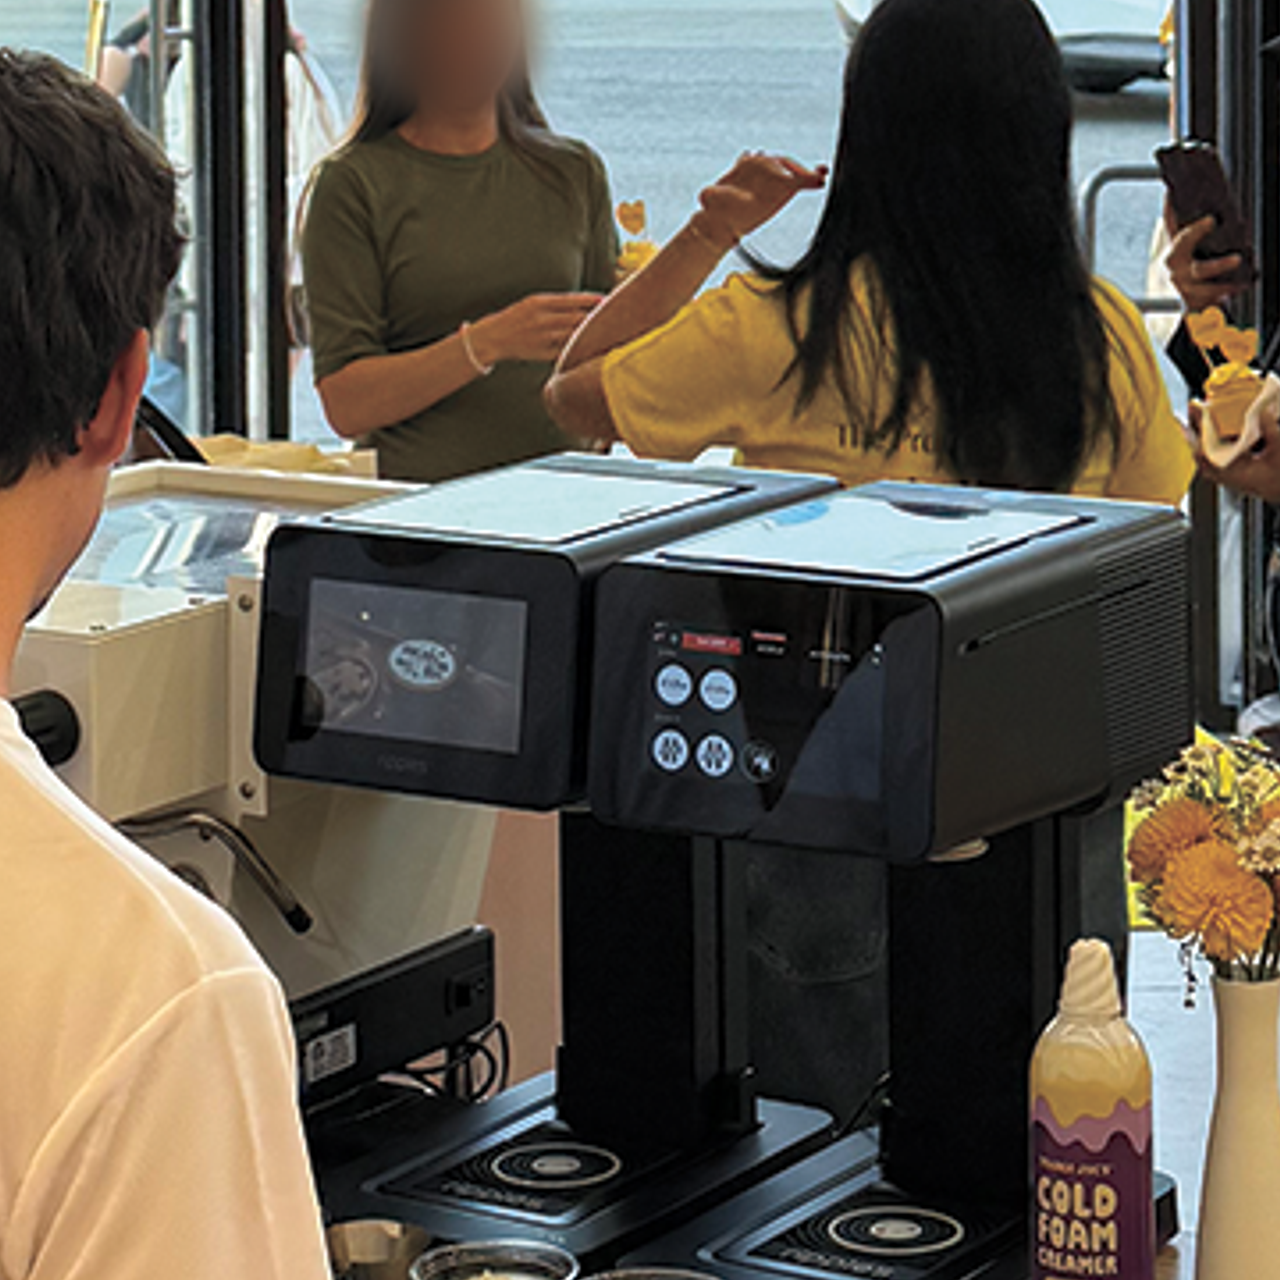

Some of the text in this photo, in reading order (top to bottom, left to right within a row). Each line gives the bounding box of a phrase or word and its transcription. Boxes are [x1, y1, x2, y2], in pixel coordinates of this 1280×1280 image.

[1037, 1175, 1118, 1219] COLD
[1037, 1211, 1117, 1253] FOAM
[1037, 1245, 1118, 1276] CREAMER
